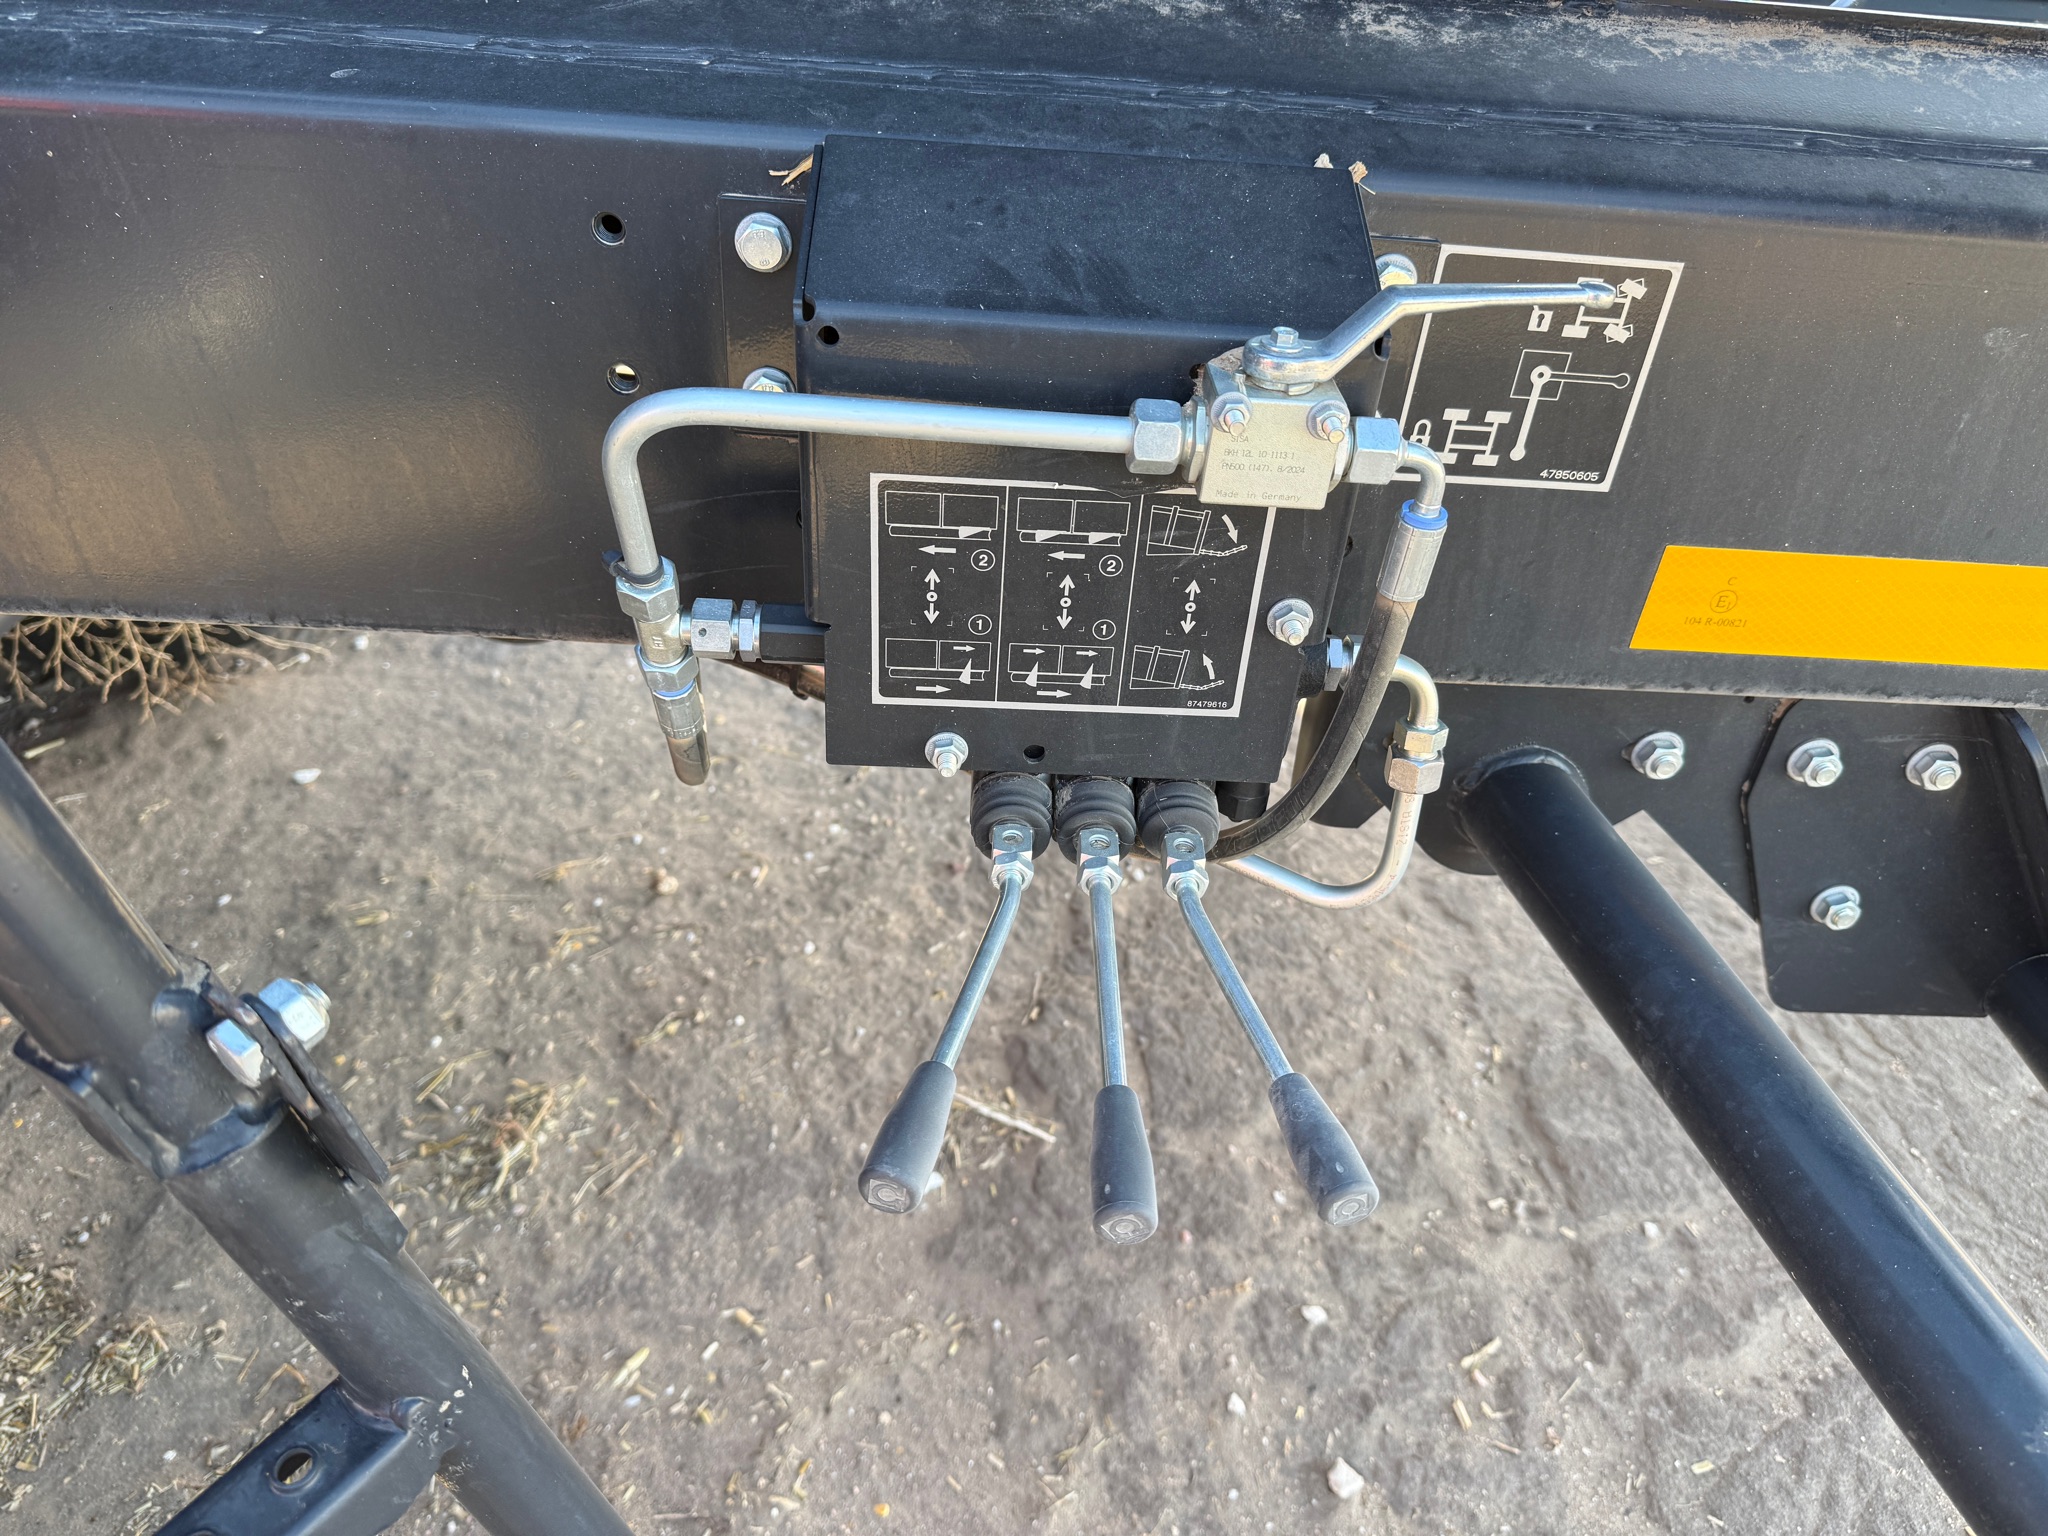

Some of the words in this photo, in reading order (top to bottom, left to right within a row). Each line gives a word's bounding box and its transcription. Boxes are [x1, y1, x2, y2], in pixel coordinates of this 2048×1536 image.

[1276, 465, 1305, 474] 8/2024
[1539, 469, 1600, 481] 47850605
[1215, 489, 1239, 498] Made
[1247, 490, 1256, 499] in
[1261, 491, 1302, 503] Germany
[1727, 576, 1738, 586] C
[1683, 616, 1702, 626] 104
[1187, 700, 1228, 708] 87479616
